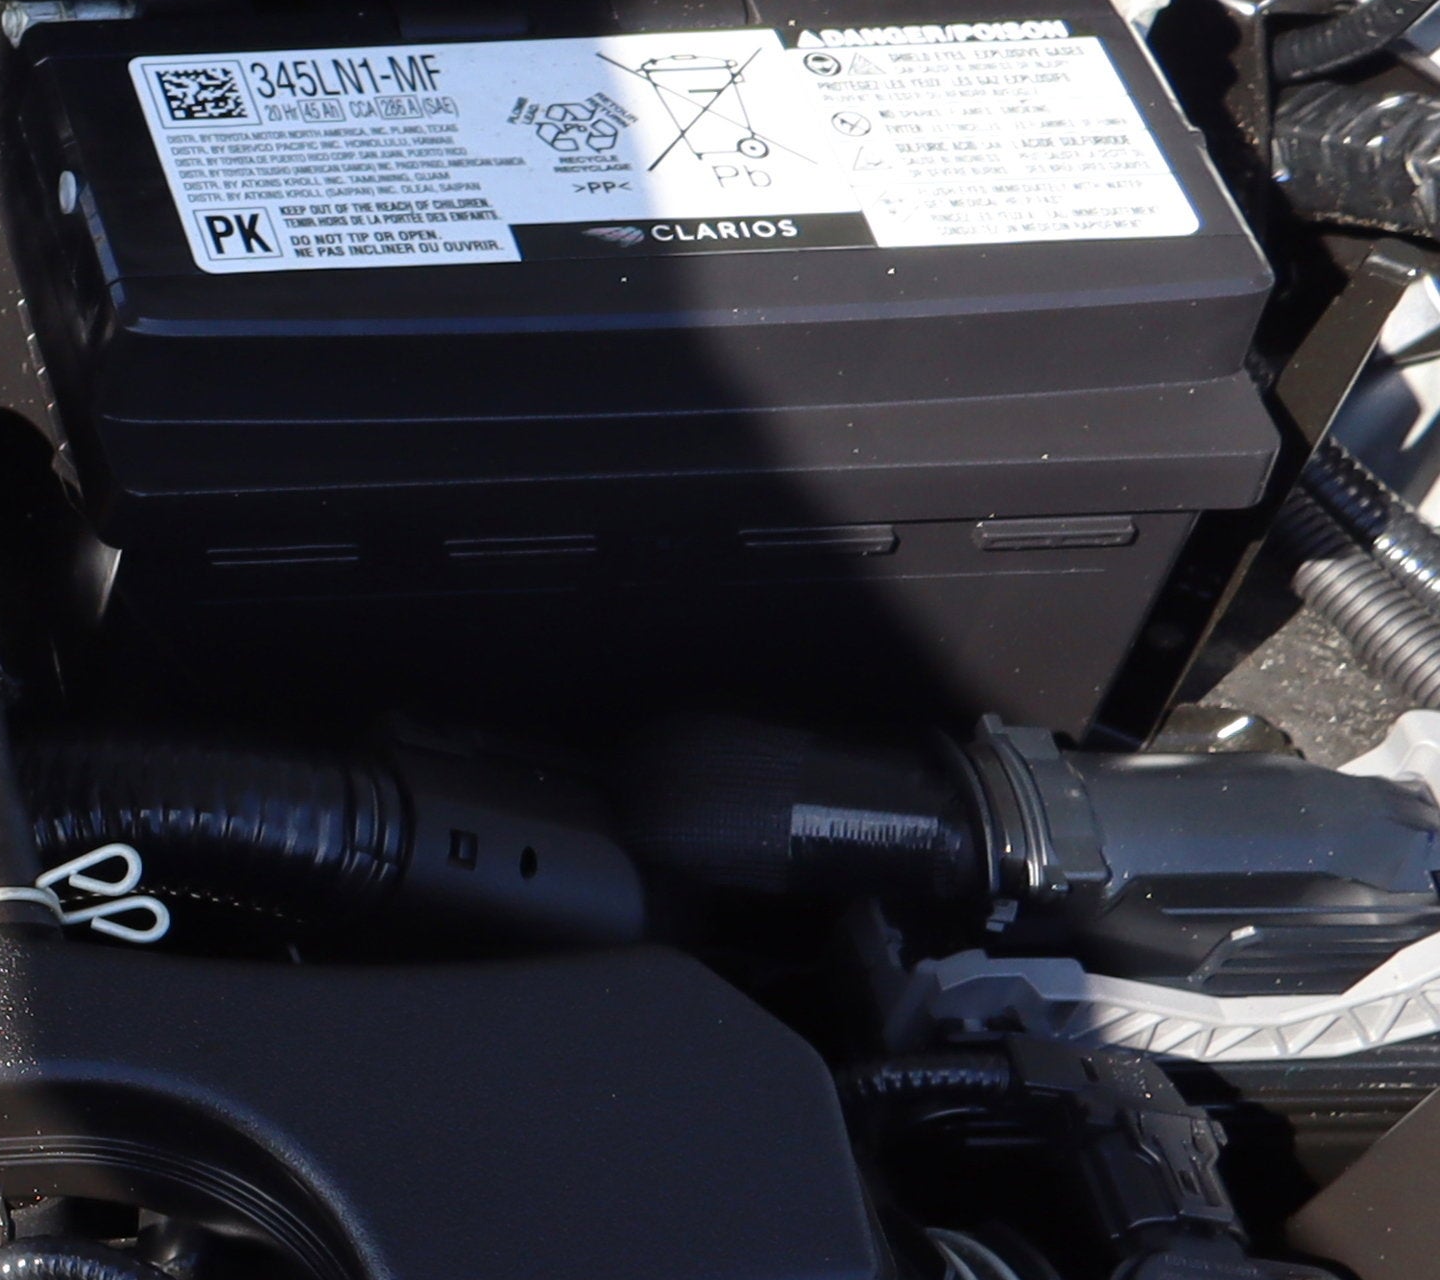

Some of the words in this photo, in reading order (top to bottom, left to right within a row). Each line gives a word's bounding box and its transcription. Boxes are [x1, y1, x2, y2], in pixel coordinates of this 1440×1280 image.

[251, 55, 440, 98] 345LN1-MF
[348, 101, 378, 117] CCA
[422, 97, 460, 119] (SAE)
[554, 163, 632, 172] RECYCLAGE
[559, 155, 618, 164] RECYCLE
[712, 165, 771, 188] Pb
[573, 181, 633, 194] >PP<
[280, 205, 307, 216] KEEP
[309, 204, 332, 215] OUT
[334, 203, 349, 214] OF
[351, 203, 373, 213] THE
[375, 201, 413, 212] REACH
[415, 200, 430, 211] OF
[204, 213, 272, 255] PK
[290, 235, 310, 246] DO
[314, 233, 343, 245] NOT
[347, 232, 370, 244] TIP
[373, 231, 395, 242] OR
[651, 220, 798, 242] CLARIOS
[294, 247, 313, 258] NE
[317, 246, 345, 257] PAS
[348, 243, 415, 256] INCLINER
[418, 242, 439, 253] OU
